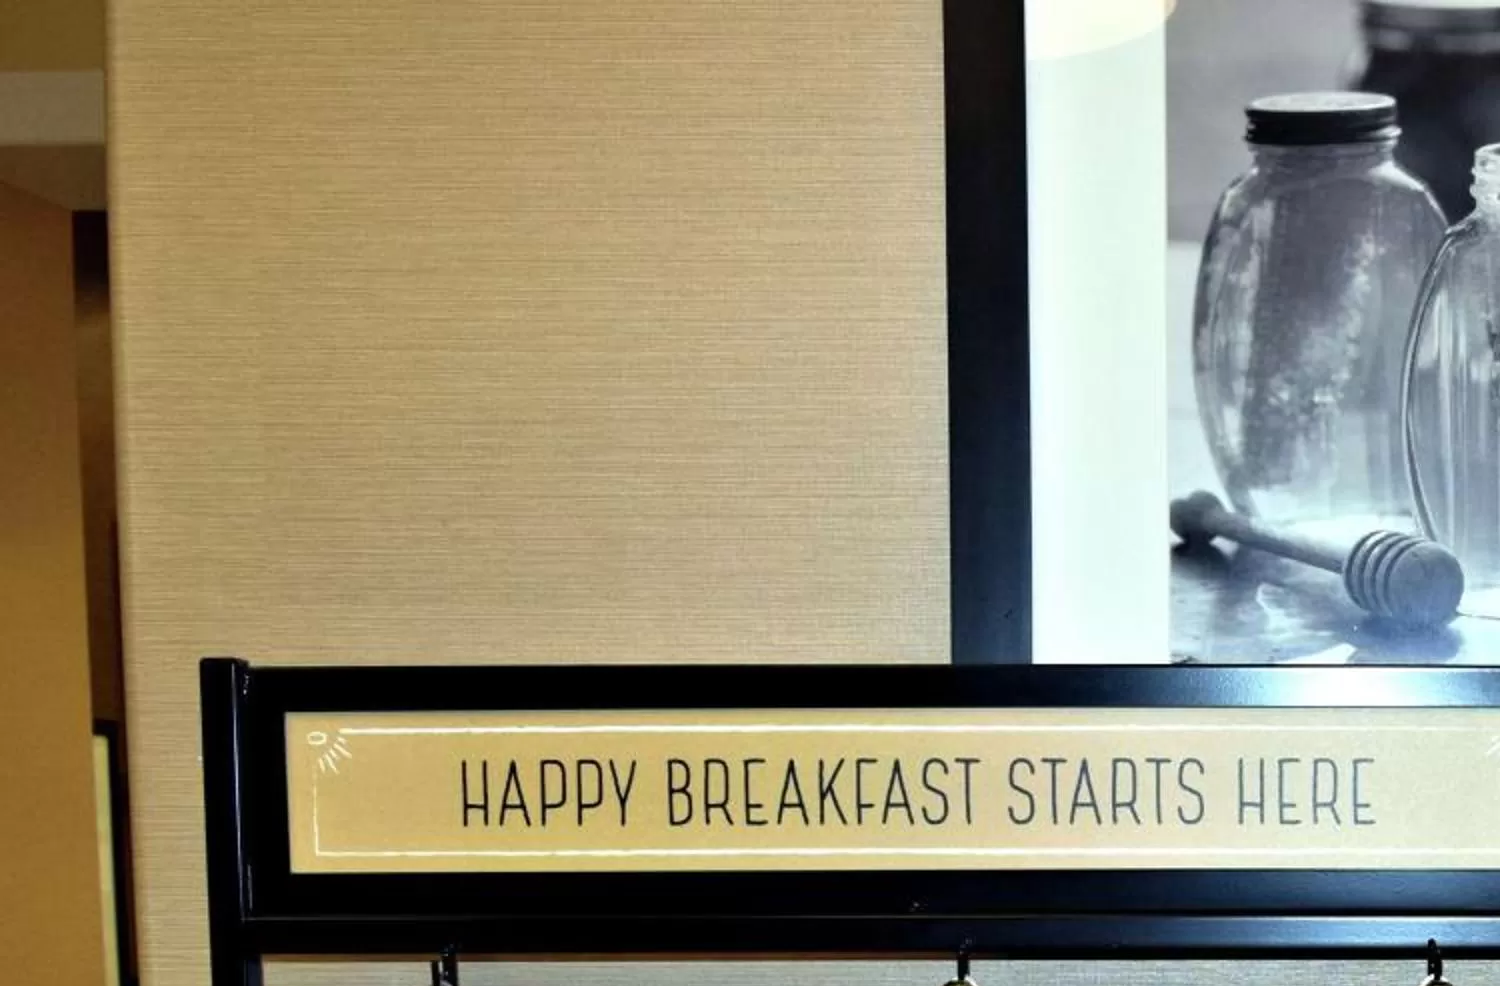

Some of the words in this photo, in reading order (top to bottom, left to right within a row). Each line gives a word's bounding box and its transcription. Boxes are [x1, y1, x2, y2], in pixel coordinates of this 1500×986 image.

[461, 758, 637, 828] HAPPY
[666, 757, 981, 827] BREAKFAST
[1007, 757, 1206, 826] STARTS
[1237, 757, 1377, 826] HERE
